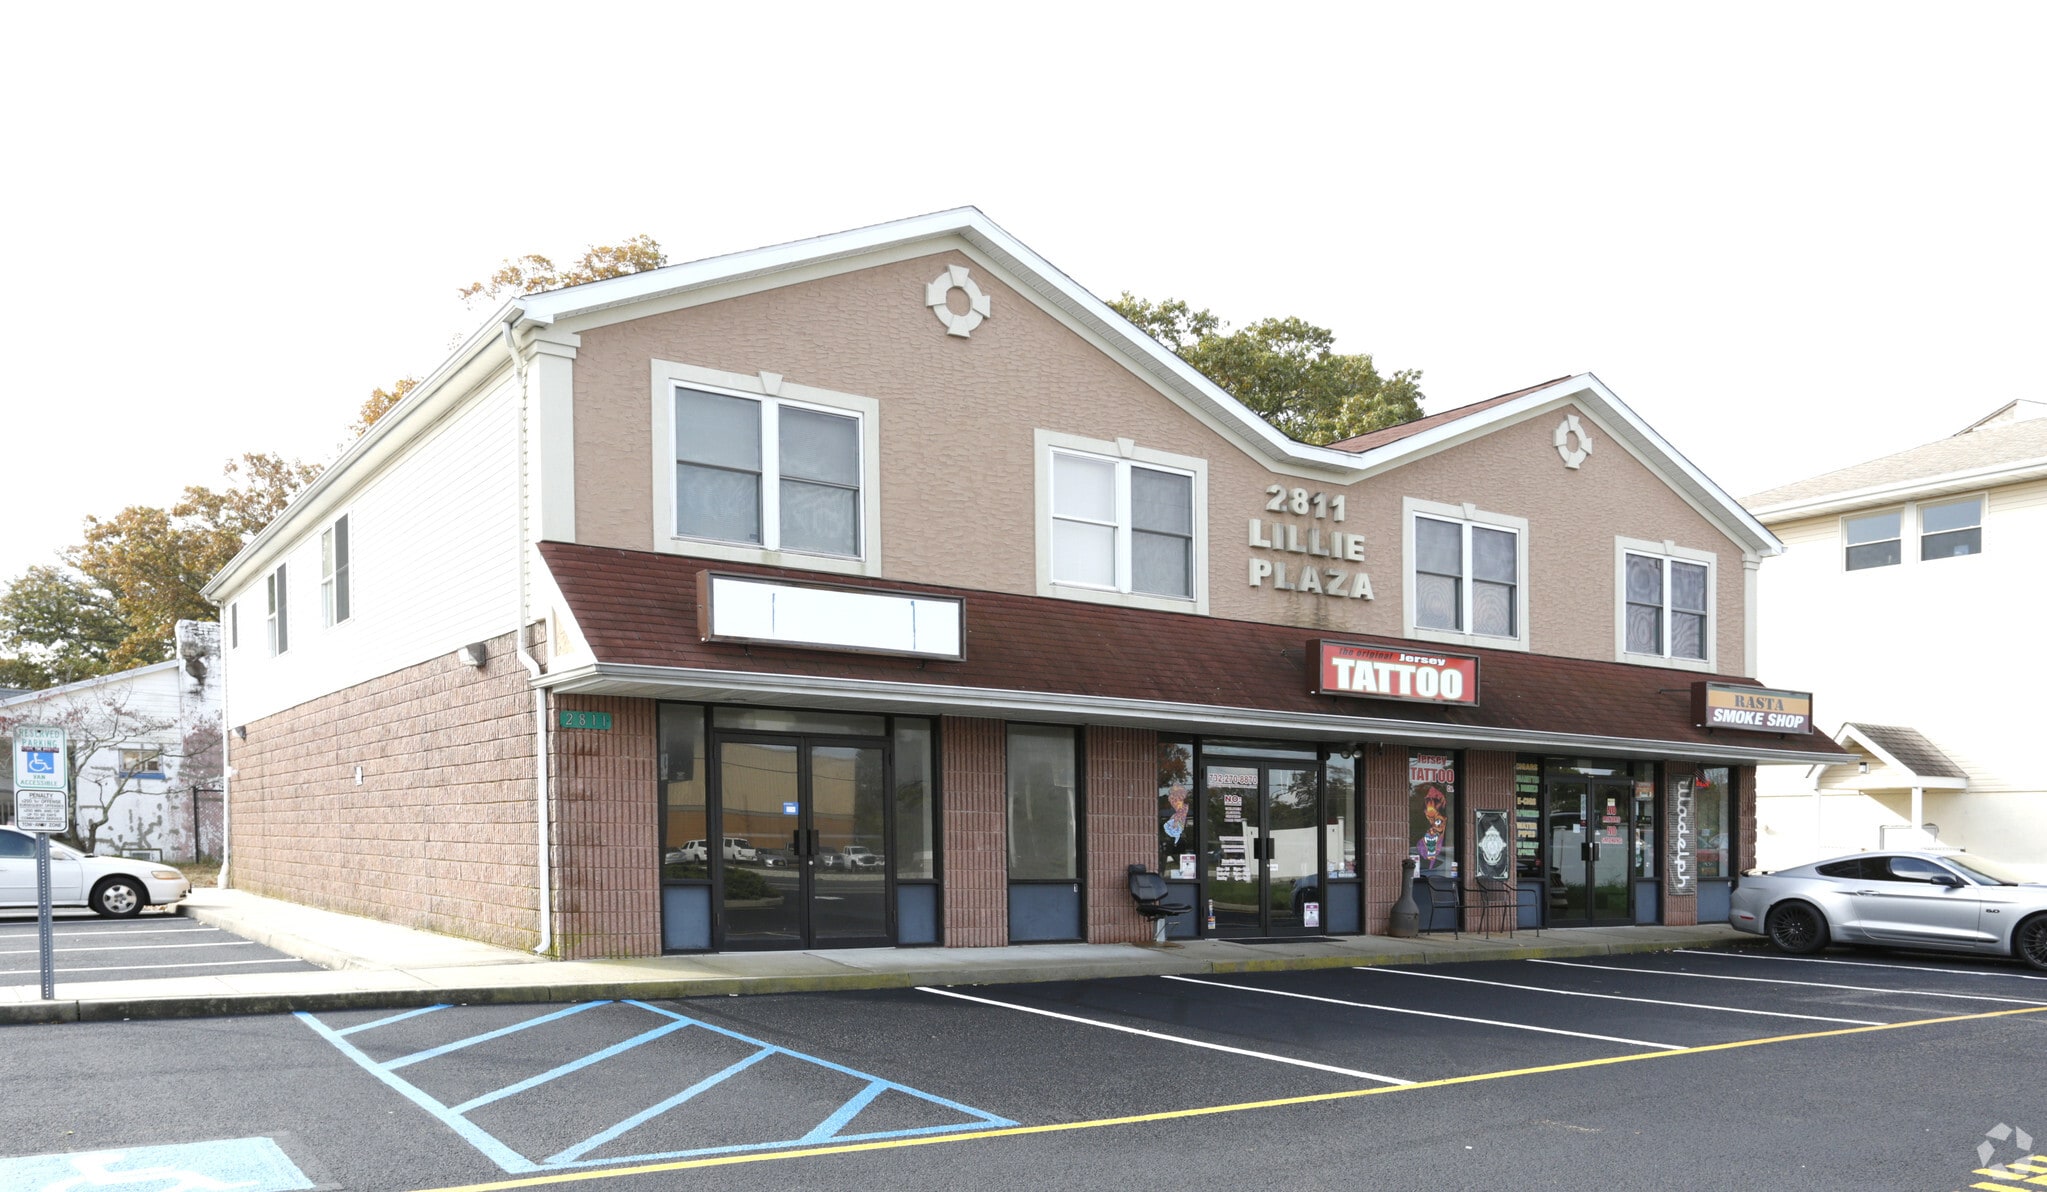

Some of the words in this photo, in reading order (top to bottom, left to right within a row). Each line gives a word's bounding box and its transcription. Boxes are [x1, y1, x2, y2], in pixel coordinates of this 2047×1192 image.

[1265, 484, 1345, 523] 2811
[1249, 518, 1365, 562] LILLIE
[1249, 558, 1375, 600] PLAZA
[1356, 649, 1394, 660] original
[1398, 653, 1446, 666] Jersey
[1332, 657, 1463, 699] TATTOO
[1734, 694, 1784, 711] RASTA
[565, 712, 606, 727] 2811
[1713, 708, 1764, 726] SMOKE
[1766, 713, 1804, 728] SHOP
[19, 728, 60, 739] RESERVED
[21, 738, 58, 748] PARKING
[1417, 753, 1447, 766] Jersey
[1410, 767, 1455, 783] TATTOO
